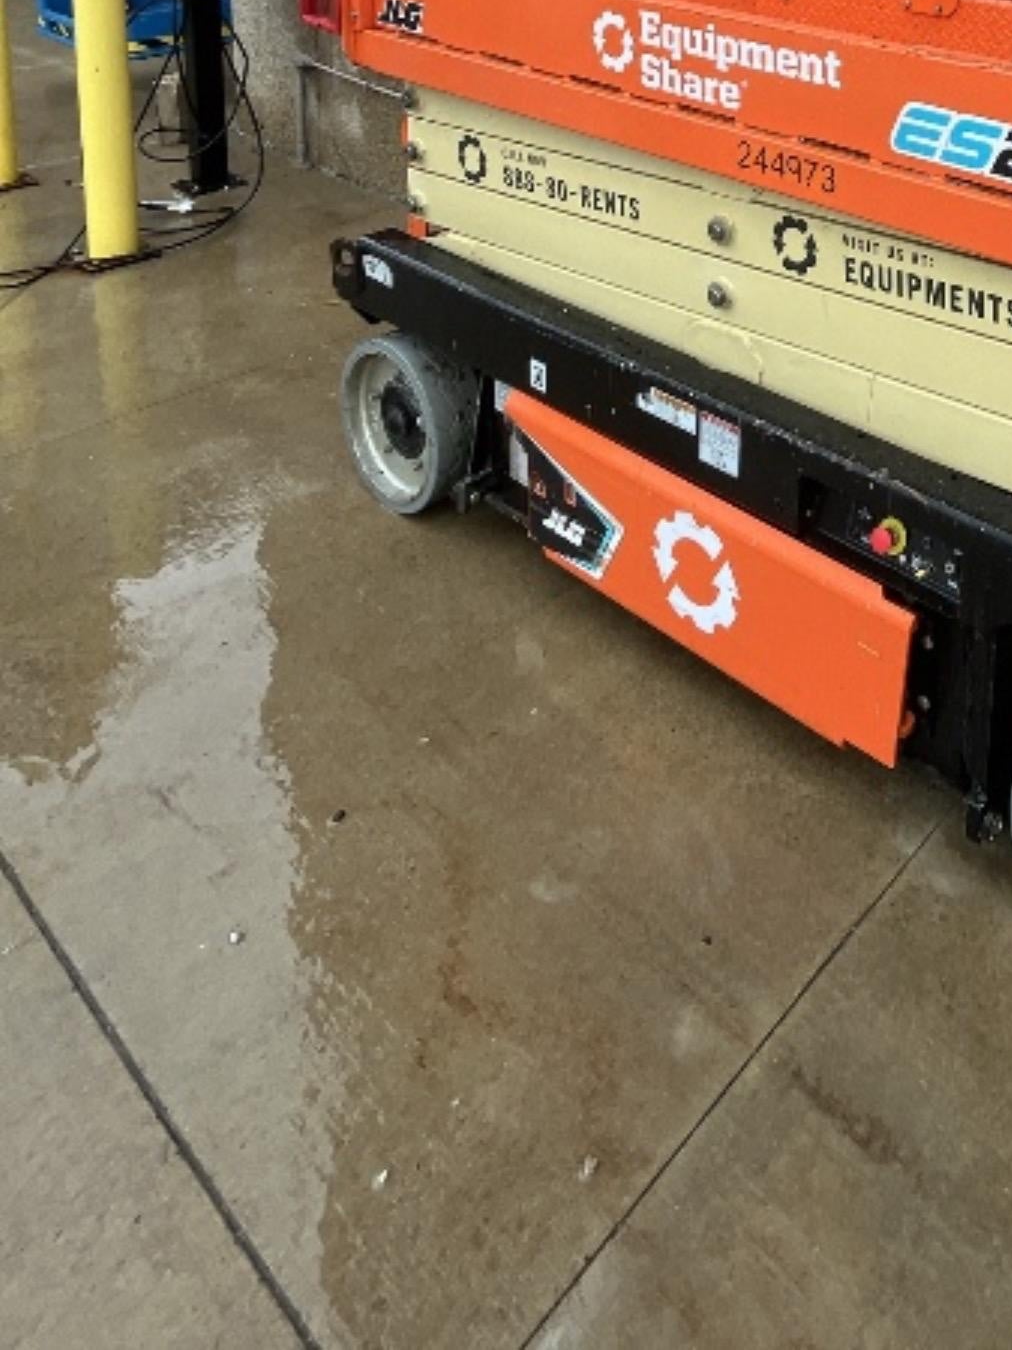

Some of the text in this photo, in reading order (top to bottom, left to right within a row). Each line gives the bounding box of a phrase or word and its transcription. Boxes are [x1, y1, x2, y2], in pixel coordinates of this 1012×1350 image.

[639, 10, 842, 90] Equipment
[640, 53, 741, 110] Share
[737, 140, 836, 194] 244973
